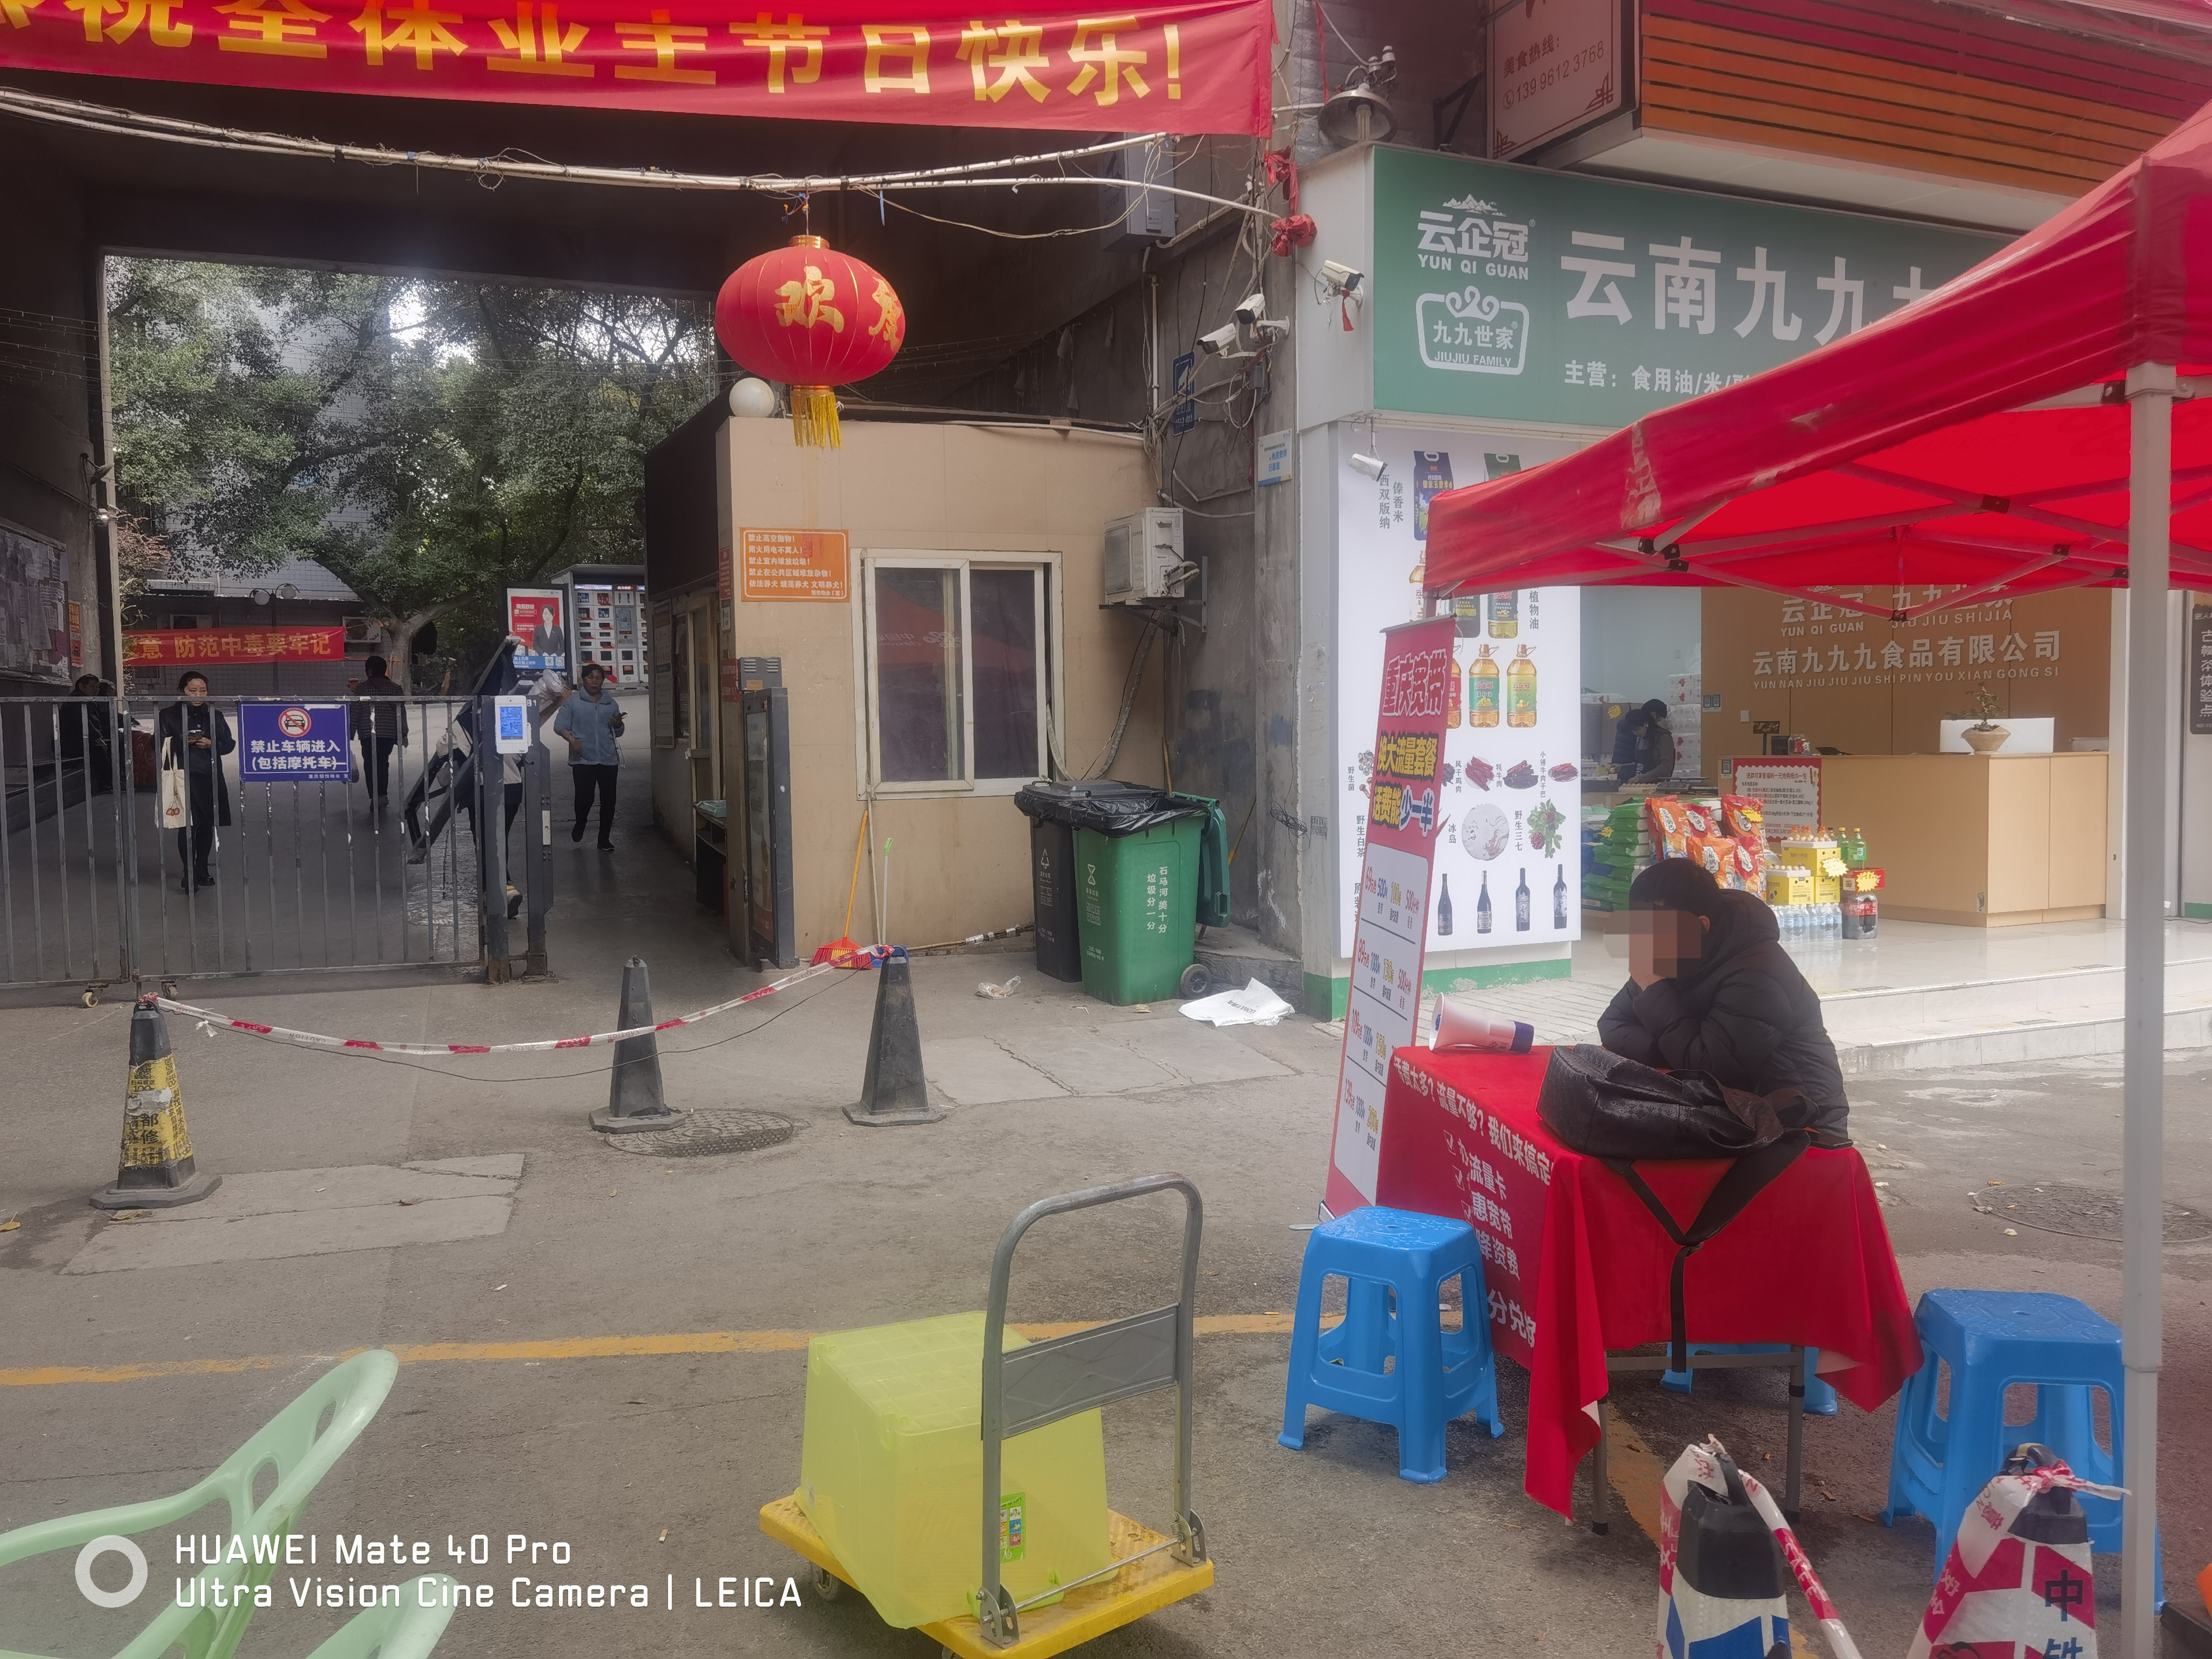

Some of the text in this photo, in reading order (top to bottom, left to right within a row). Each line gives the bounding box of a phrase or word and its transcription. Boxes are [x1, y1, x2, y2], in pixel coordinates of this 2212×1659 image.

[0, 0, 1182, 106] 祝全体业主节日快乐！
[1504, 33, 1560, 79] 美食热线：
[1516, 41, 1604, 103] 139 9612 3768
[1418, 211, 1529, 262] 云企冠
[1418, 254, 1529, 280] YUN QI GUAN
[1433, 320, 1514, 350] 九九世家
[1434, 350, 1512, 368] JIUJIU FAMILY
[1379, 474, 1391, 530] 西双版纳
[1392, 481, 1404, 523] 傣香米
[1529, 585, 1539, 630] 植物油
[1922, 614, 1949, 626] JIU
[174, 632, 332, 658] 防范中毒要牢记
[1781, 622, 1864, 637] YUN QI GUAN
[1752, 630, 2060, 677] 云南九九九食品有限公司
[251, 739, 341, 754] 禁止车辆进入
[252, 756, 337, 771] （包括摩托车）
[1377, 736, 1438, 778] 换大流量套餐
[1356, 815, 1365, 858] 野生白茶
[1448, 823, 1457, 844] 冰岛
[1514, 810, 1523, 851] 野生三七
[1468, 1182, 1513, 1240] 惠宽带
